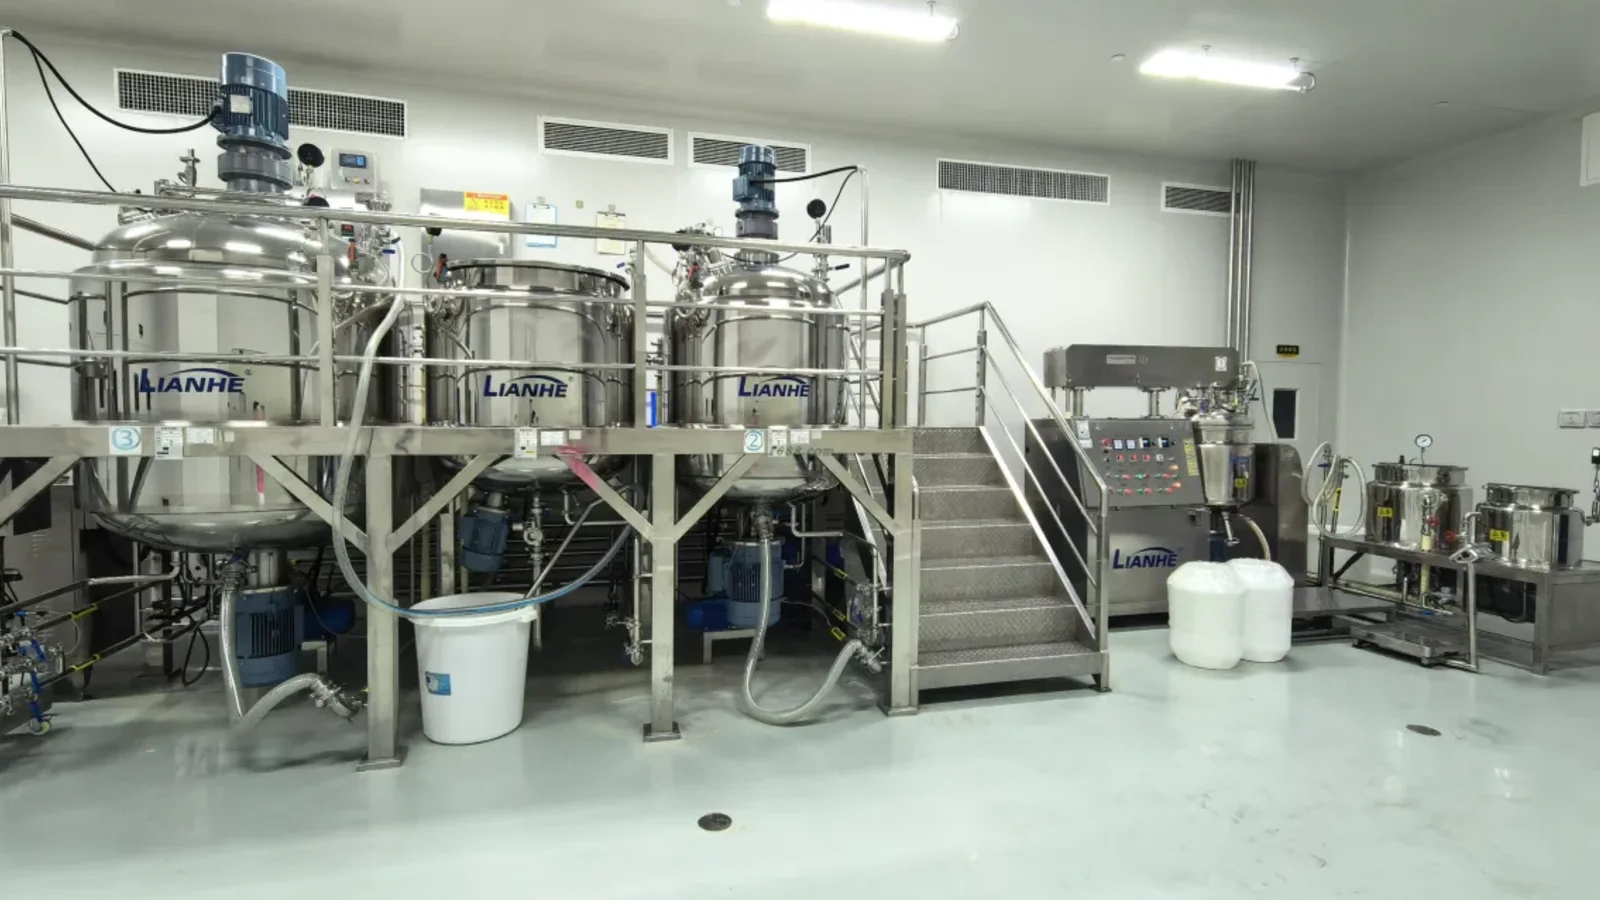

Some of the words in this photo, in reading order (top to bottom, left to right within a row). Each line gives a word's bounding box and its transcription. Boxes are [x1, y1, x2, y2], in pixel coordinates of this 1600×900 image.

[139, 367, 245, 393] LIANHE
[483, 374, 568, 398] LIANHE
[738, 376, 810, 397] LIANHE
[1112, 547, 1178, 569] LIANHE
